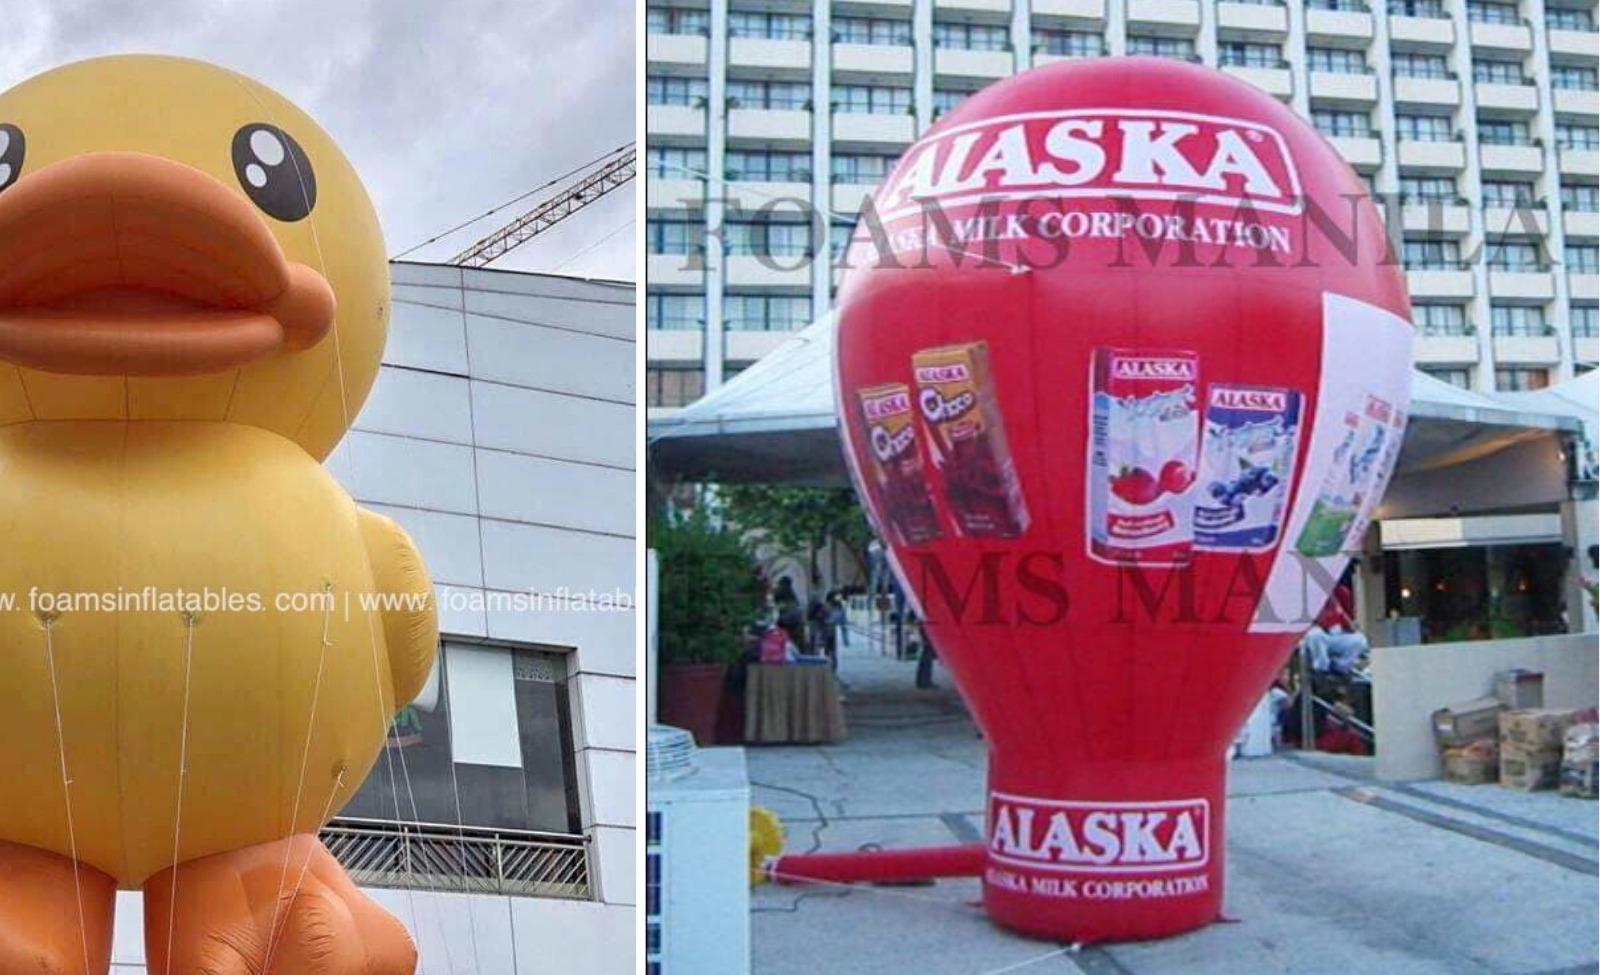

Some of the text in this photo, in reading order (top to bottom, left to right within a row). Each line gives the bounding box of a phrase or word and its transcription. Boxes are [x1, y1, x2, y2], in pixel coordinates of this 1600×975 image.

[889, 118, 1280, 207] ALASKA
[1038, 211, 1291, 254] CORPORATION
[1119, 361, 1192, 377] ALASKA
[1217, 392, 1282, 409] ALASKA
[992, 804, 1202, 865] ALASKA
[1032, 877, 1078, 897] MILK
[1082, 874, 1209, 899] CORPORATION
